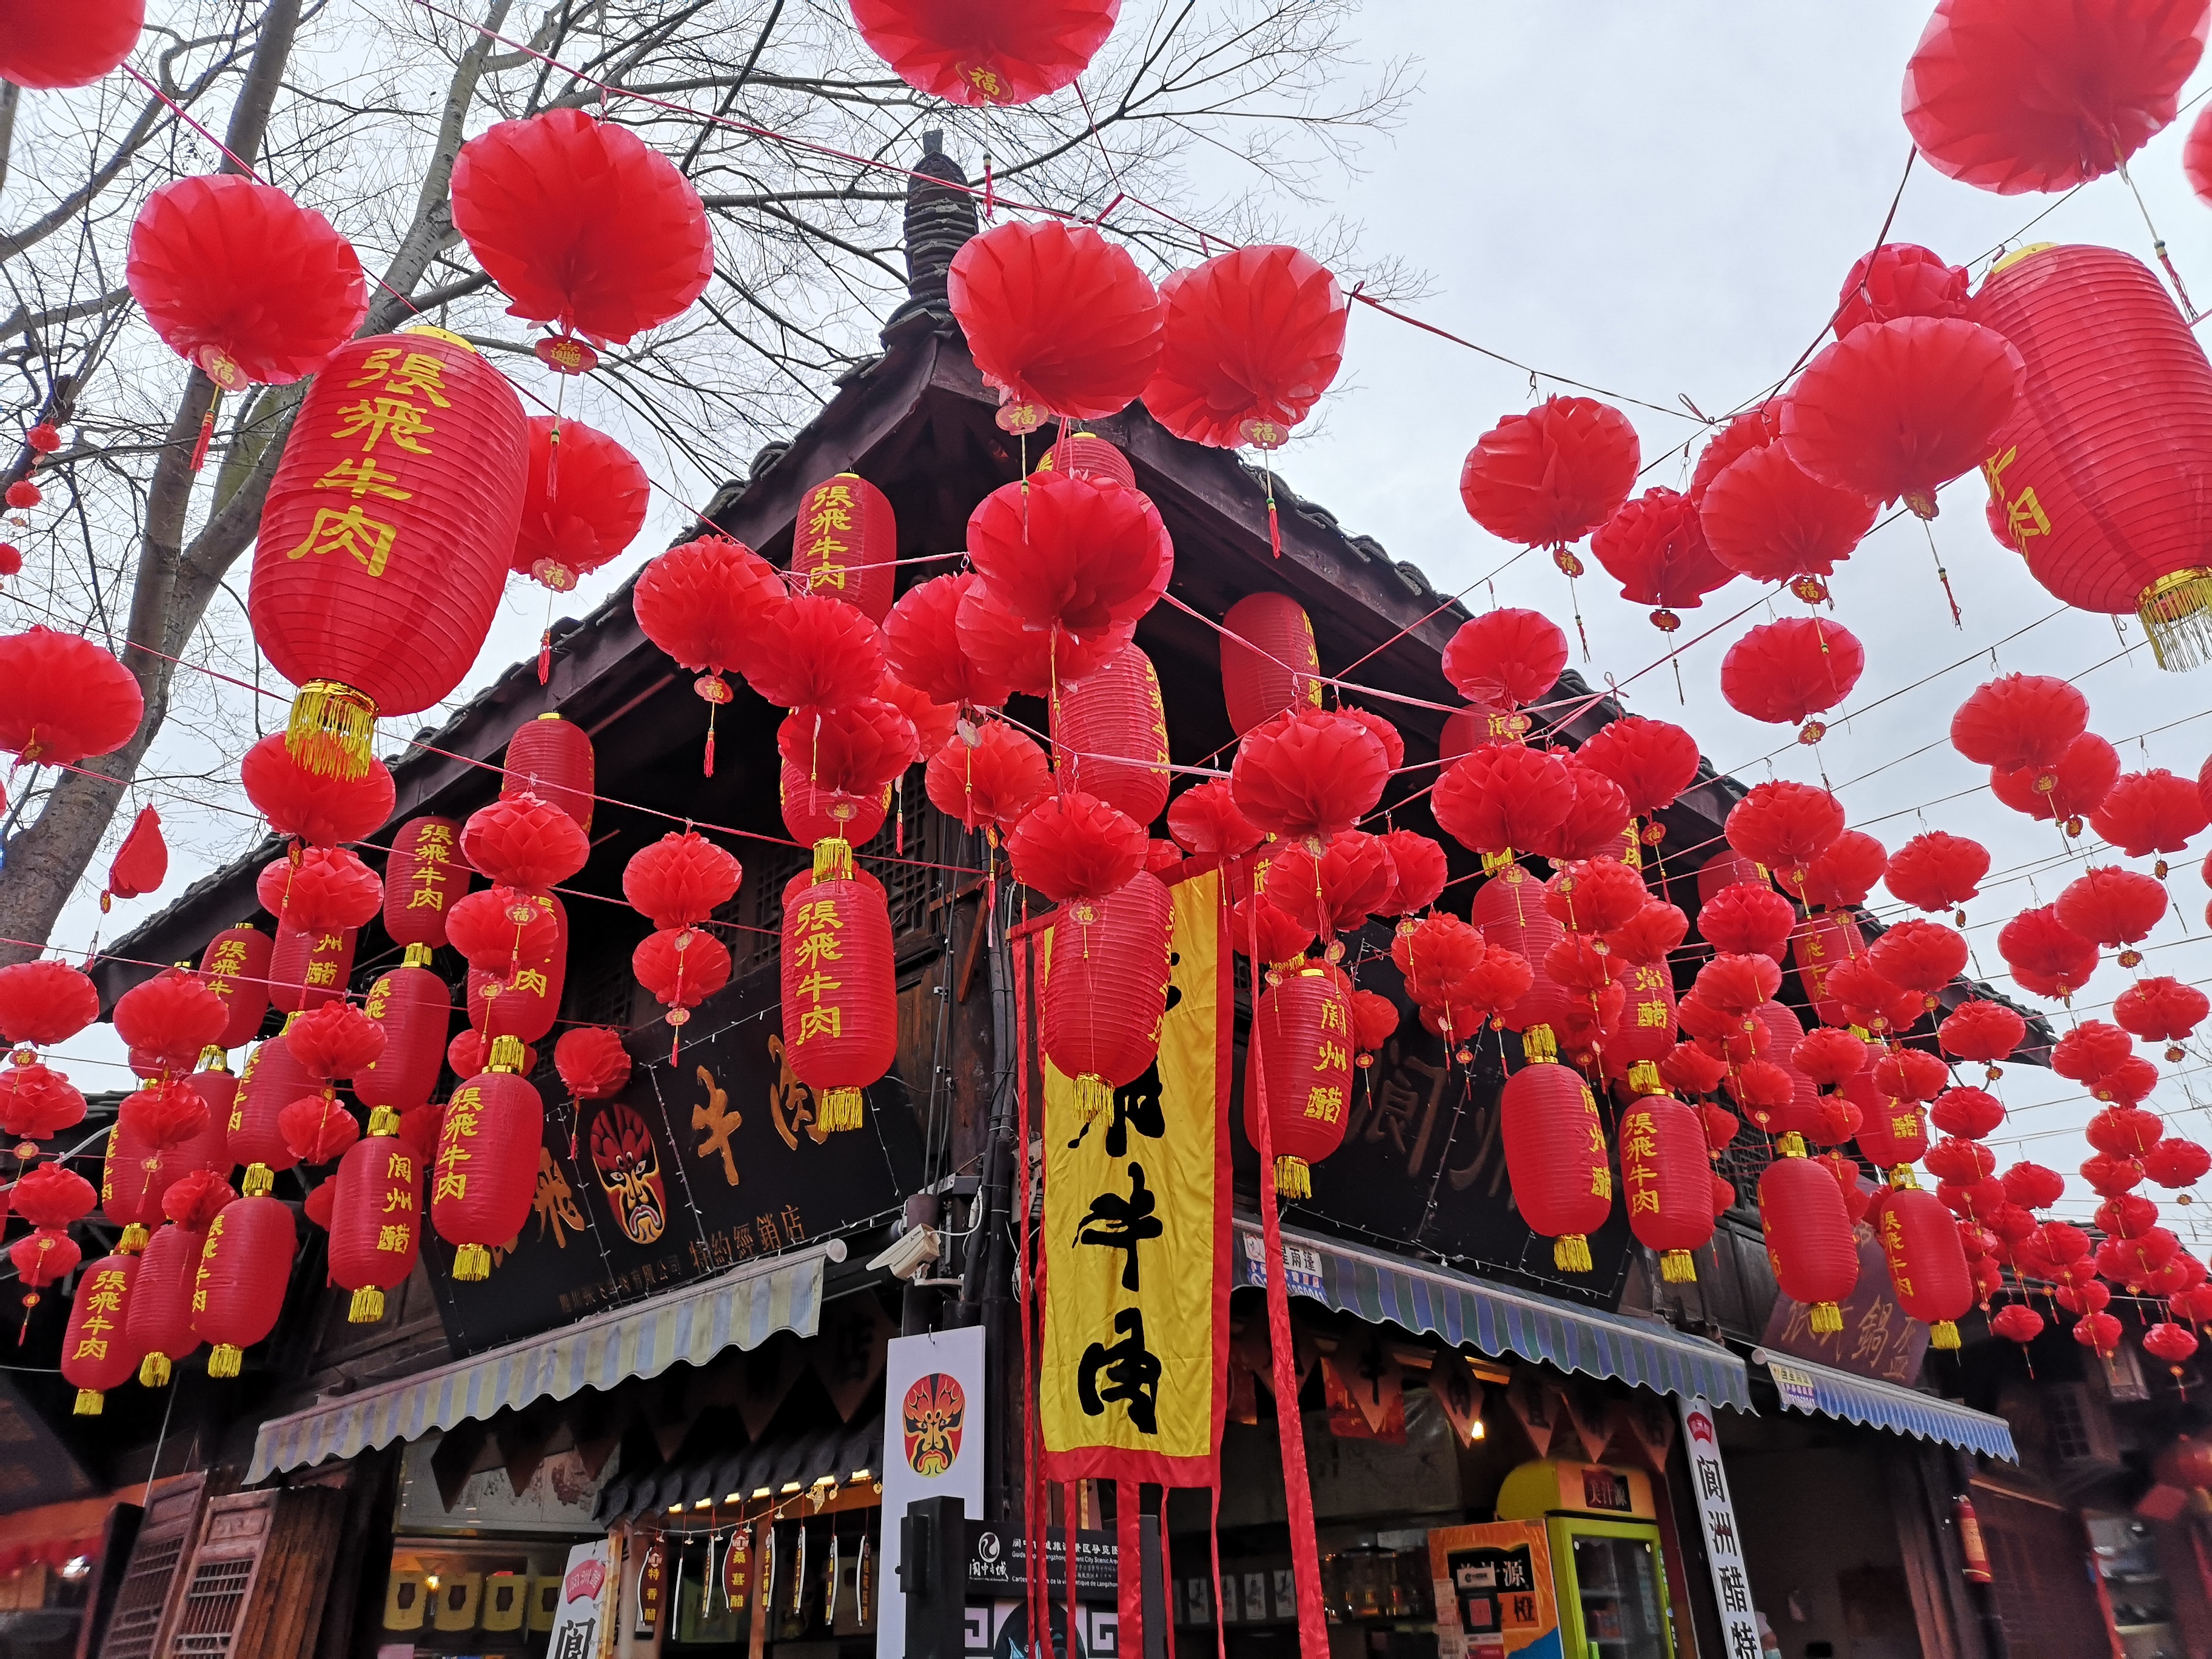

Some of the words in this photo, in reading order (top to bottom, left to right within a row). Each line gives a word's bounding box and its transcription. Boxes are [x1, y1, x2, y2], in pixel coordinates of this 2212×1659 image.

[968, 66, 1000, 96] 福
[212, 355, 235, 384] 福
[1008, 404, 1037, 427] 福
[1250, 421, 1277, 441] 福
[287, 349, 451, 577] 張飛牛肉
[806, 486, 855, 591] 張飛牛肉
[1559, 552, 1577, 572] 福
[543, 565, 565, 588] 福
[1797, 581, 1818, 598] 福
[705, 680, 724, 699] 福
[1804, 724, 1820, 742] 福
[1306, 836, 1321, 854] 福
[1646, 826, 1660, 842] 福
[406, 824, 454, 911] 張飛牛肉
[1792, 869, 1803, 883] 福
[513, 907, 530, 922] 福
[1076, 906, 1093, 922] 福
[1835, 913, 1849, 925] 福
[1401, 921, 1414, 933] 福
[207, 940, 247, 997] 張飛牛
[306, 934, 343, 987] 州醋
[794, 900, 844, 1046] 張飛牛肉
[1634, 965, 1667, 1029] 州醋
[672, 1011, 684, 1022] 福
[16, 1051, 31, 1064] 福
[1304, 998, 1347, 1124] 阆州醋
[432, 1087, 485, 1206] 張飛牛肉
[146, 1158, 158, 1170] 福
[1623, 1112, 1660, 1218] 張飛牛肉
[377, 1153, 414, 1255] 阆州醋
[71, 1270, 127, 1361] 張飛牛肉
[1084, 1556, 1094, 1565] City
[644, 1567, 660, 1621] 特香醋
